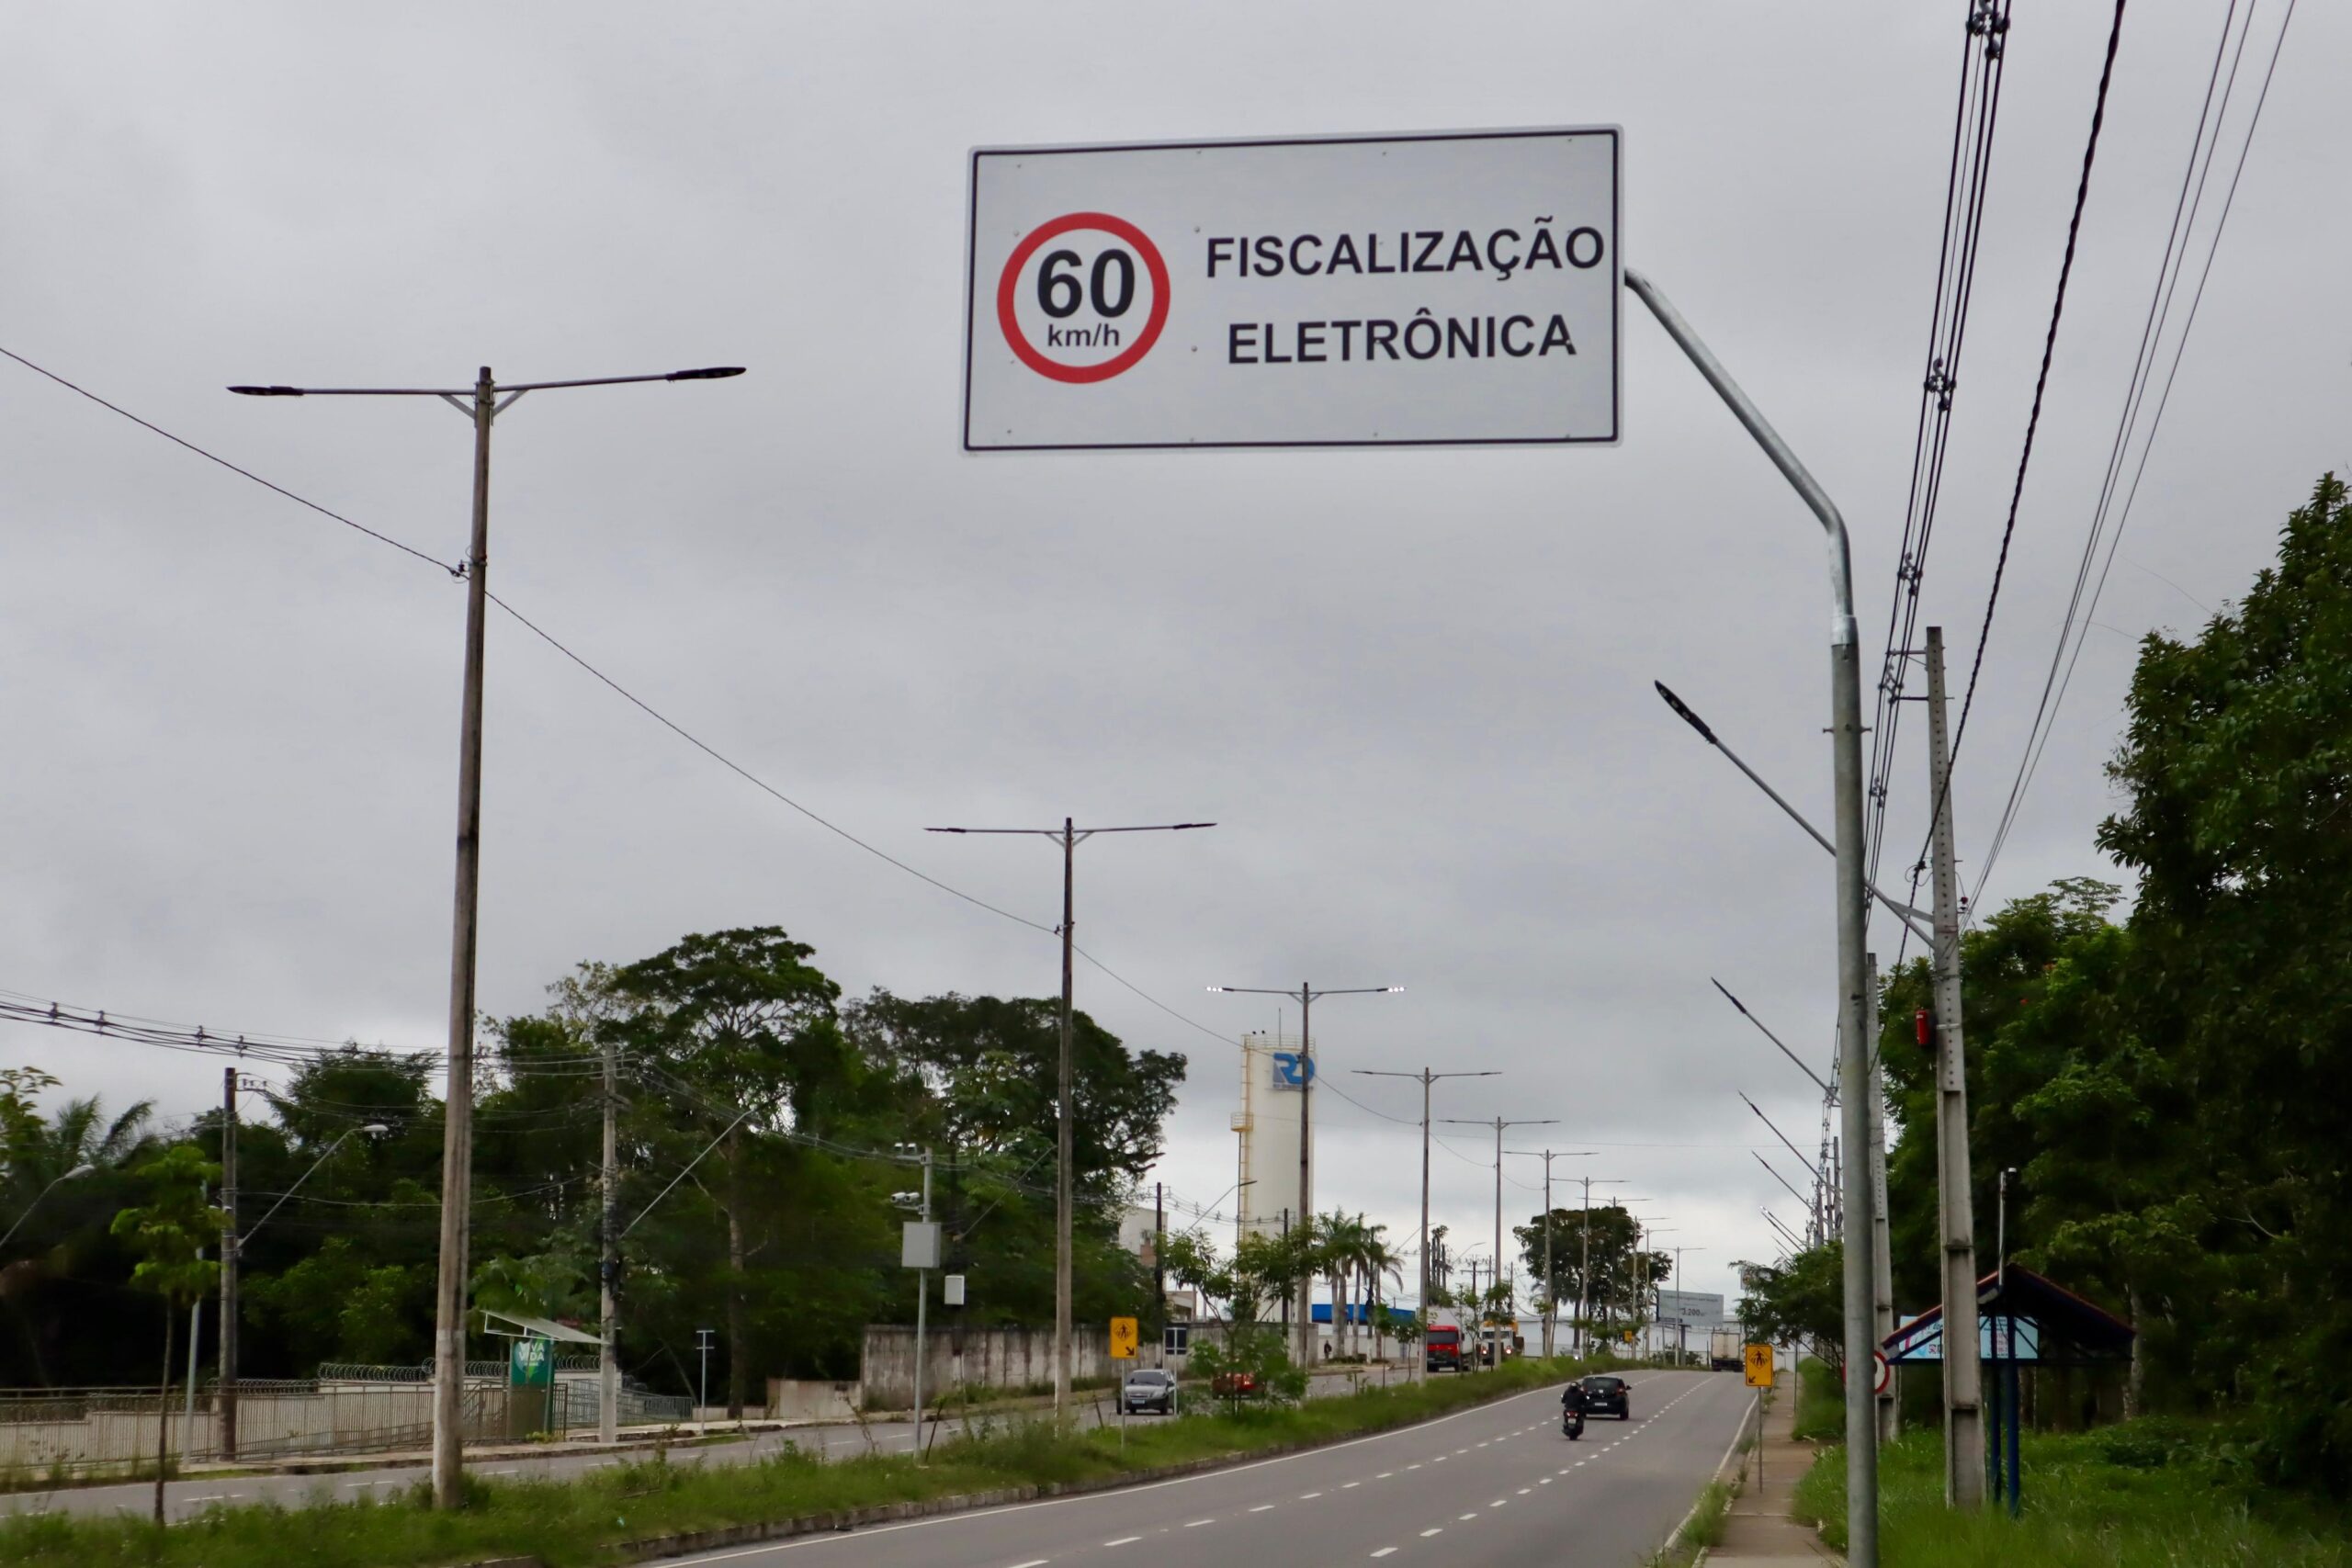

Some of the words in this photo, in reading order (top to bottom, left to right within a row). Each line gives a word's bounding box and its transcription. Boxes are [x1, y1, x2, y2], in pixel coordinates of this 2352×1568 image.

[1207, 216, 1605, 281] FISCALIZAÇÃO
[1036, 248, 1136, 319] 60
[1047, 322, 1121, 348] km/h
[1228, 307, 1577, 365] ELETRÔNICA
